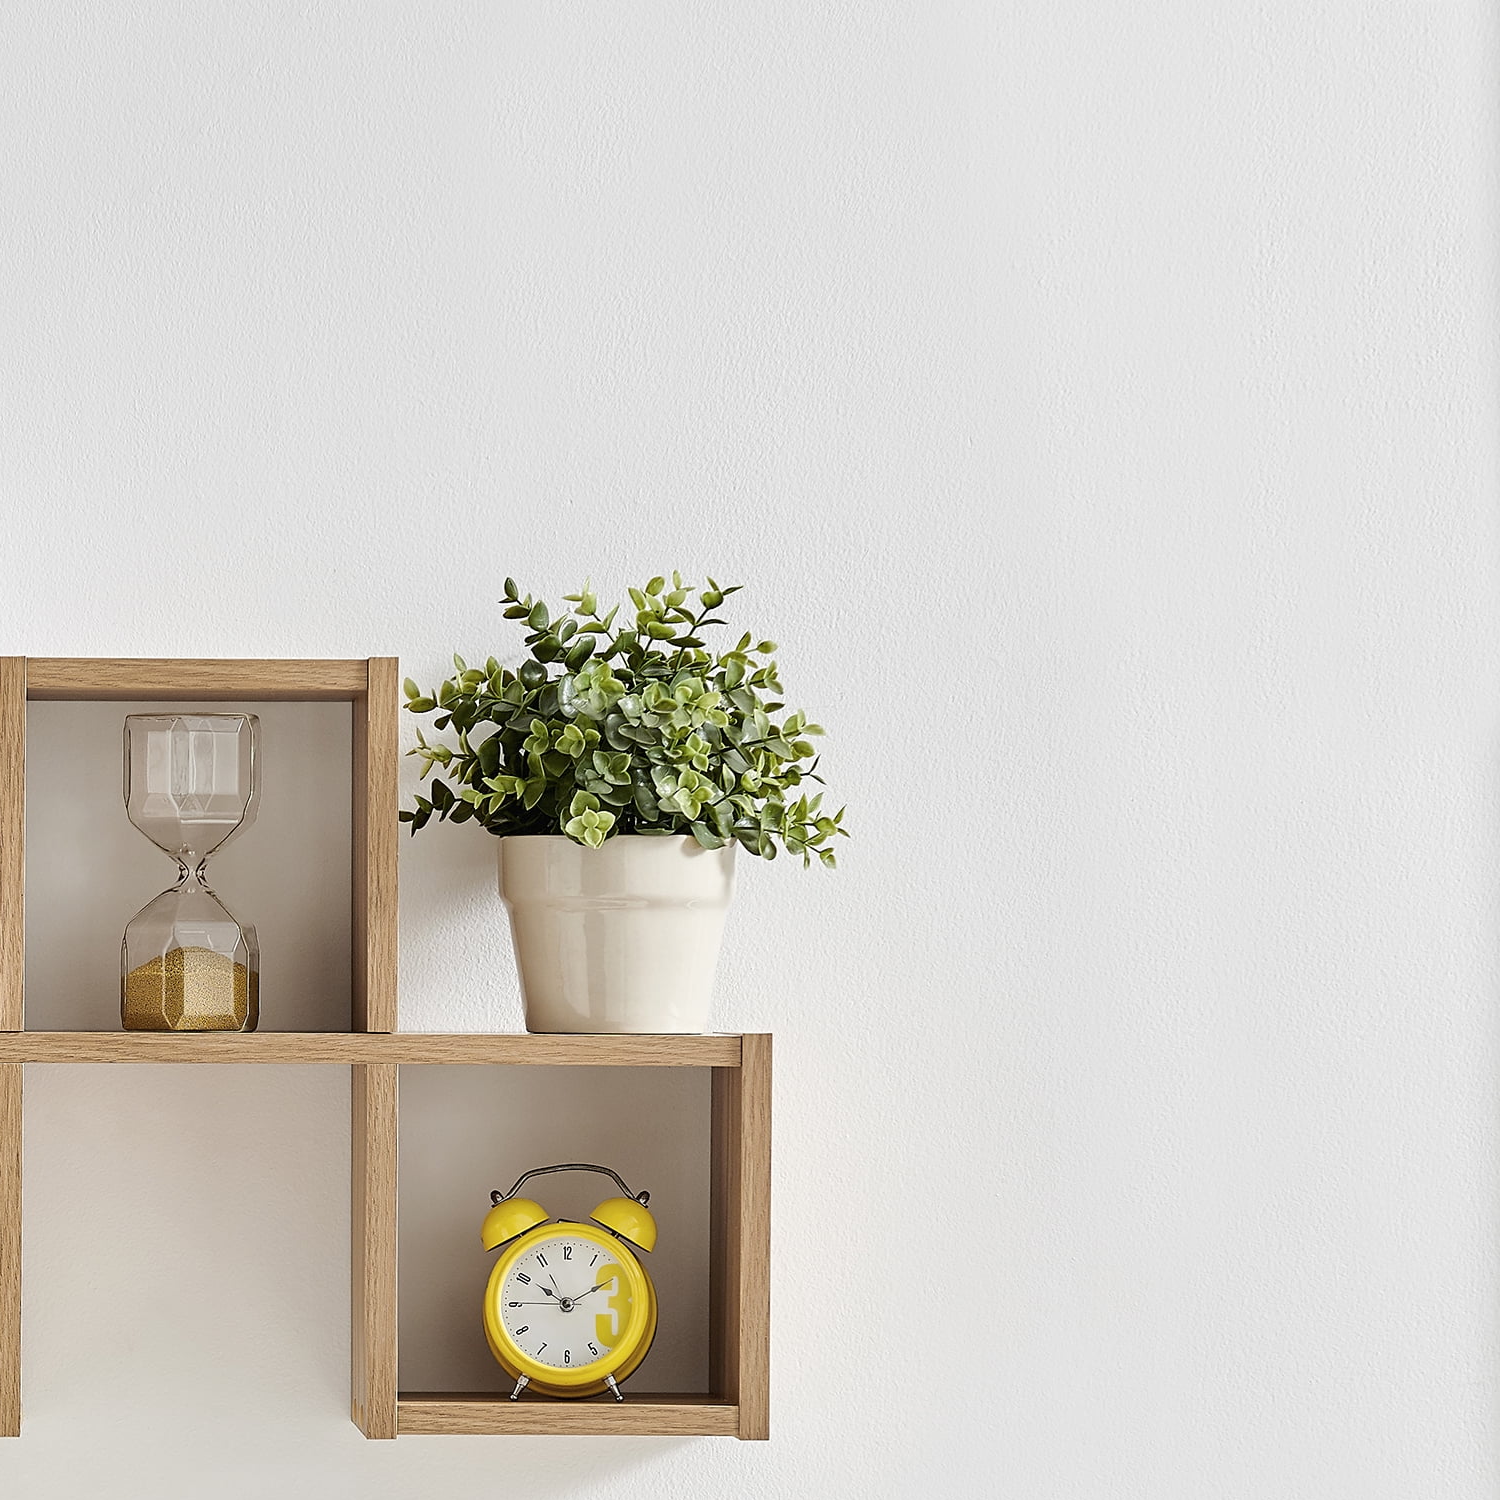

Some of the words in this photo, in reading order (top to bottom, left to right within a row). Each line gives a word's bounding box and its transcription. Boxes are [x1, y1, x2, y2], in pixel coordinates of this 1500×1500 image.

[563, 1246, 572, 1260] 12
[536, 1253, 549, 1267] 11
[590, 1255, 598, 1266] 1
[516, 1273, 531, 1285] 10
[596, 1264, 632, 1348] 3
[516, 1326, 529, 1335] 8
[537, 1343, 548, 1355] 7
[588, 1342, 598, 1355] 5
[564, 1350, 570, 1363] 6
